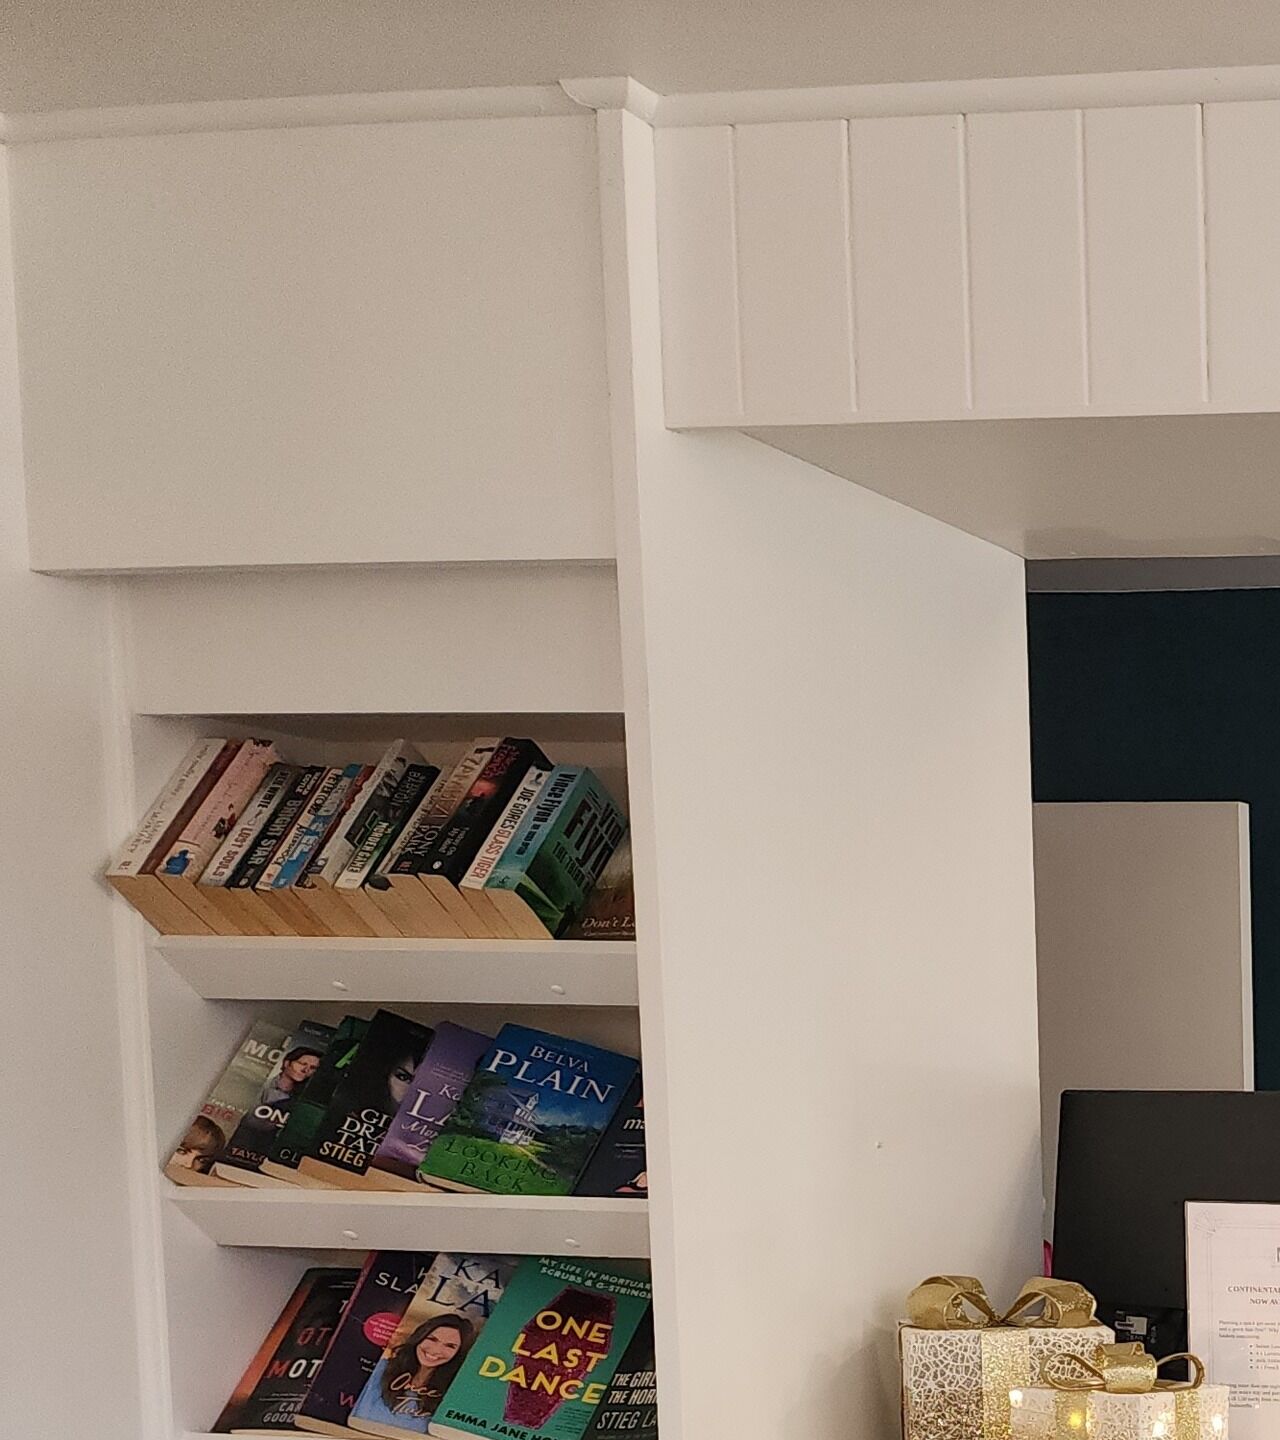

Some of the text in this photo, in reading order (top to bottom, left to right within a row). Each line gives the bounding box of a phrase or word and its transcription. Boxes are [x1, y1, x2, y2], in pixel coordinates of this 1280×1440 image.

[518, 787, 536, 803] JOE
[531, 773, 577, 824] Vince Flynn
[266, 800, 300, 837] BRIGHT
[500, 800, 527, 833] GORES
[231, 827, 253, 849] LOST
[247, 838, 277, 866] STAR
[400, 824, 429, 855] PARK
[413, 824, 443, 857] TONY
[485, 829, 514, 857] GLASS
[212, 849, 239, 877] SOULS
[346, 848, 370, 873] GAME
[470, 854, 496, 879] TIGER
[582, 917, 619, 929] Don't
[529, 1045, 590, 1073] BELVA
[486, 1049, 616, 1104] PLAIN
[319, 1141, 367, 1168] STIEG
[444, 1139, 559, 1185] LOOKING
[459, 1161, 530, 1193] BACK
[540, 1266, 583, 1284] SCRUBS
[559, 1261, 582, 1274] LIFE
[427, 1277, 494, 1319] LA
[1249, 1297, 1268, 1305] NOW
[535, 1310, 614, 1345] ONE
[511, 1333, 609, 1373] LAST
[477, 1355, 608, 1406] DANCE
[611, 1373, 632, 1388] THE
[607, 1390, 630, 1405] THE
[445, 1409, 488, 1429] EMMA
[490, 1423, 529, 1440] JANE
[596, 1410, 641, 1430] STIEG
